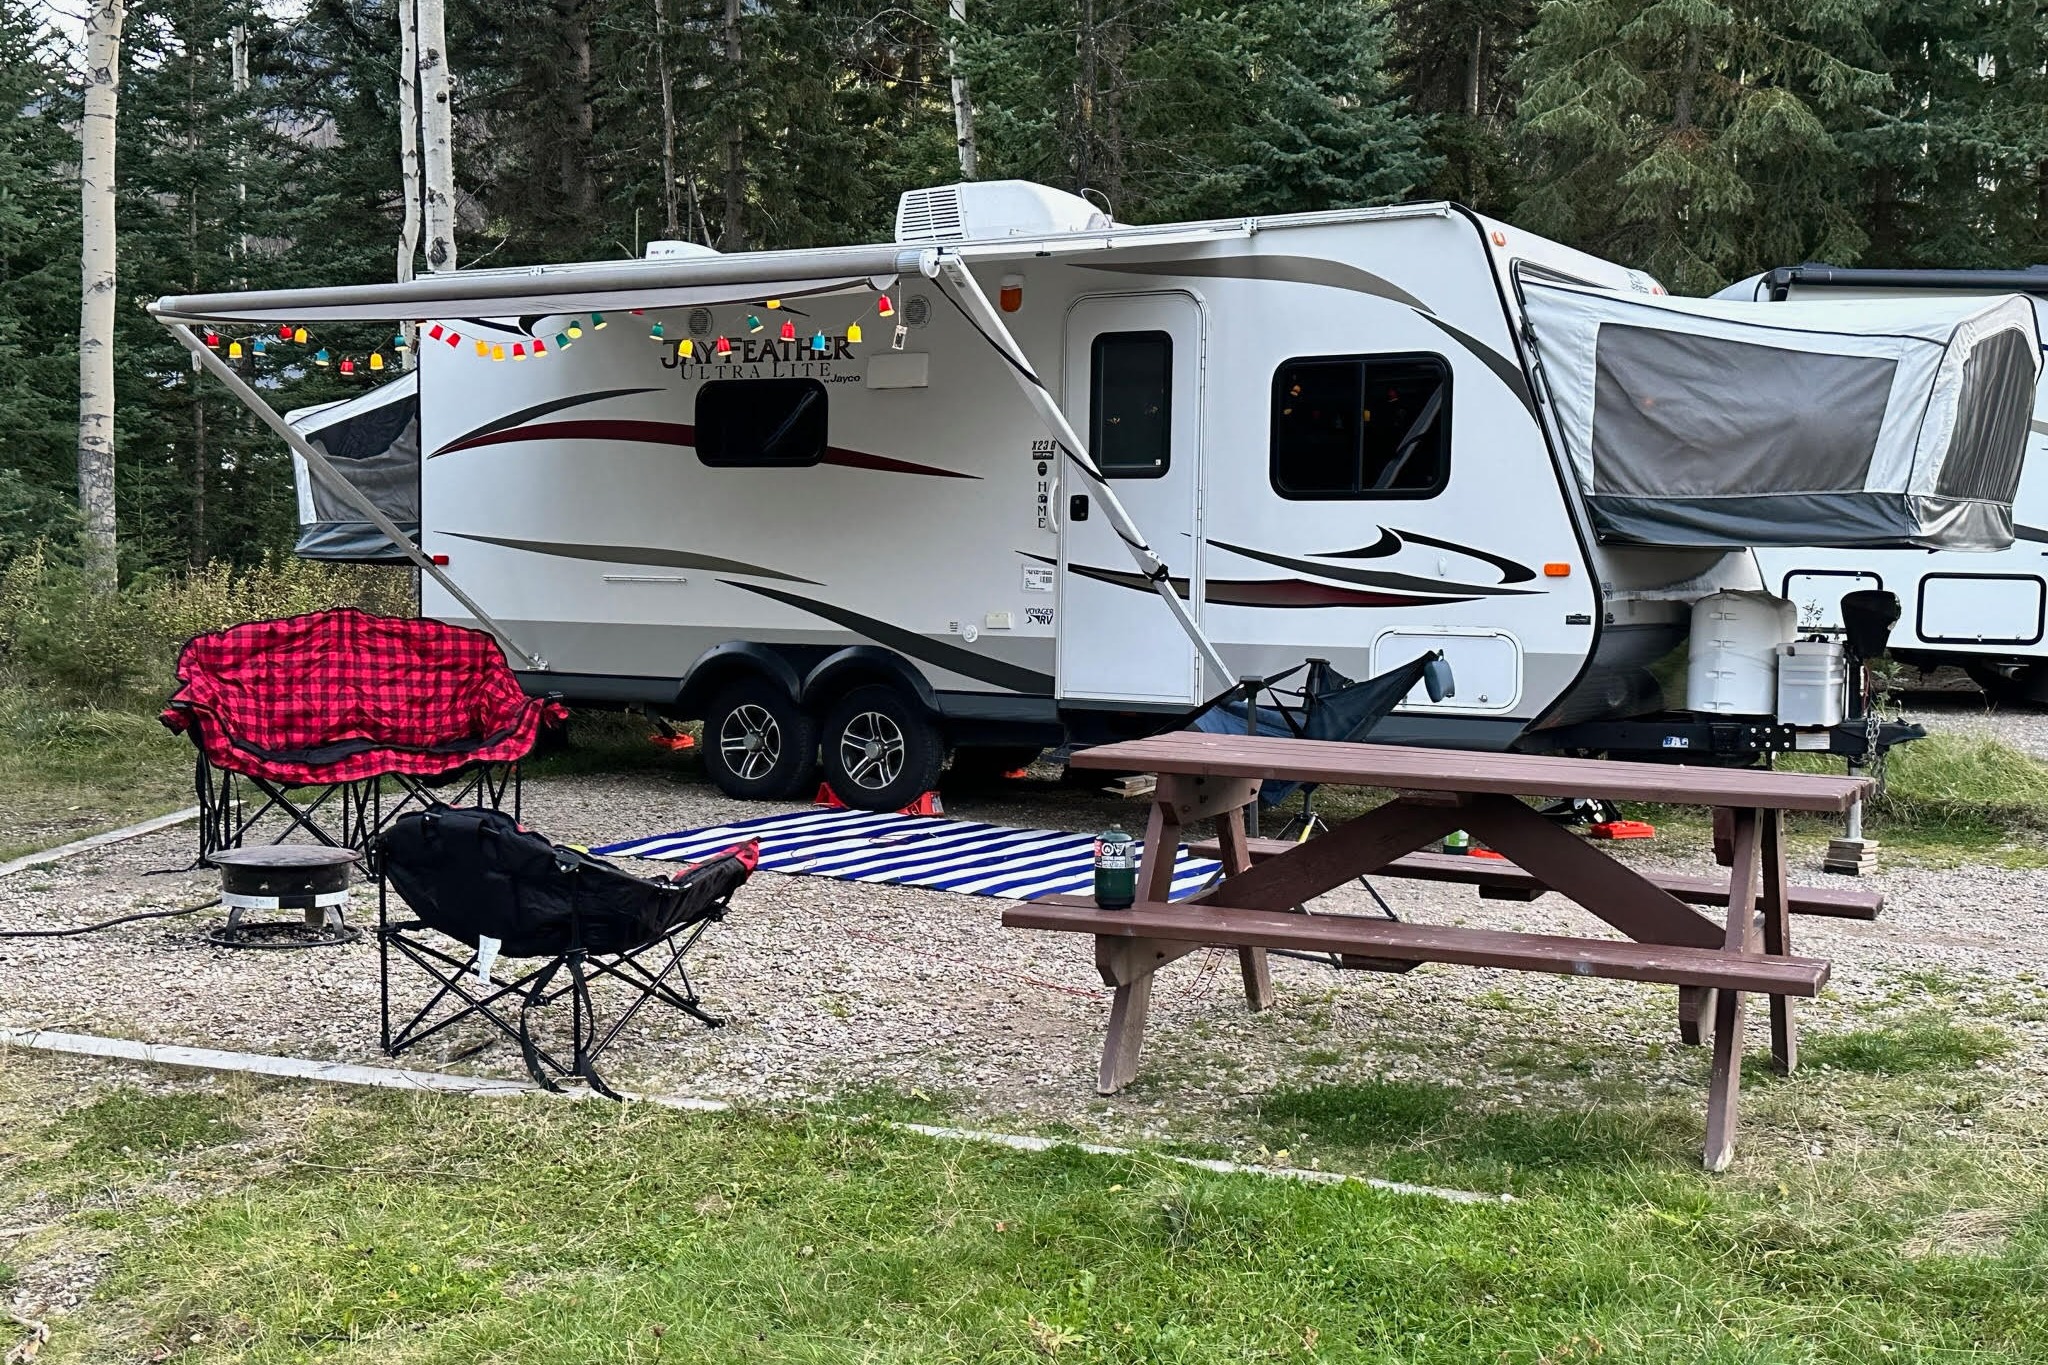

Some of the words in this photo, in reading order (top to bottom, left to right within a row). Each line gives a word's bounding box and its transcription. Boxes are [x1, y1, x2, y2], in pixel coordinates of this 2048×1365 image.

[681, 363, 760, 380] ULTRA
[773, 361, 831, 378] LITE
[830, 374, 861, 384] Jayco
[1024, 607, 1054, 615] VOYAGER
[1039, 614, 1054, 625] RV
